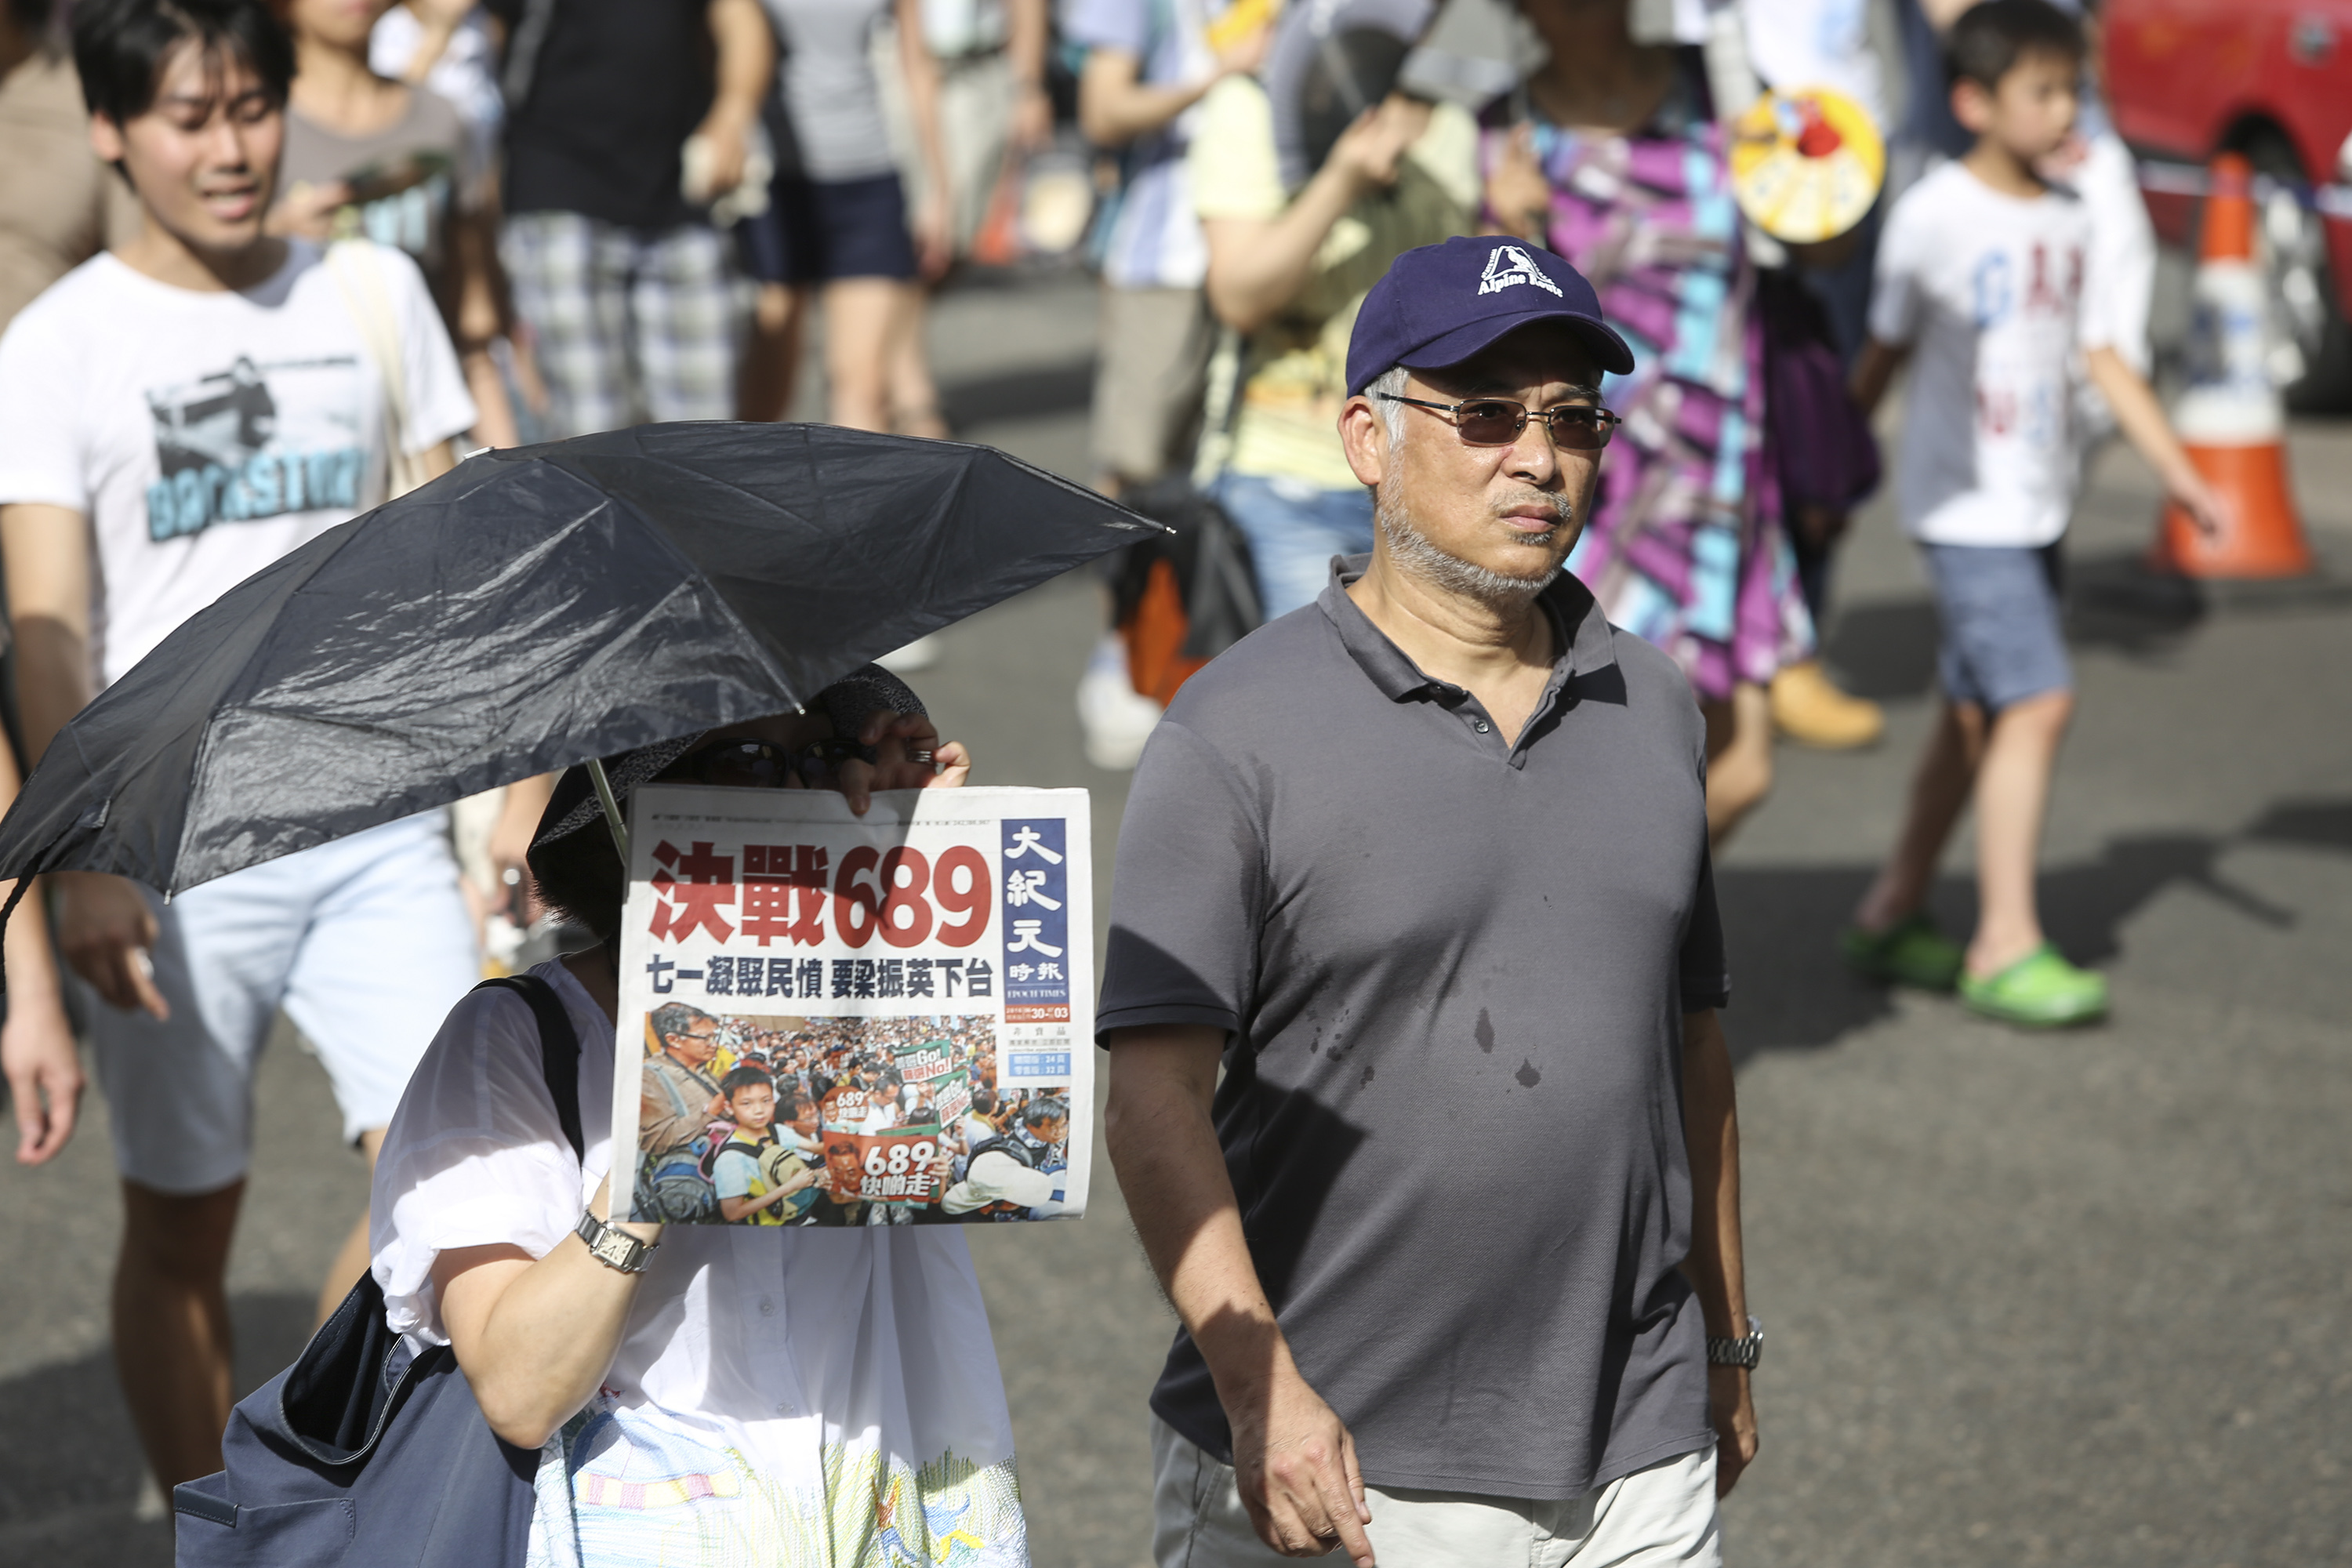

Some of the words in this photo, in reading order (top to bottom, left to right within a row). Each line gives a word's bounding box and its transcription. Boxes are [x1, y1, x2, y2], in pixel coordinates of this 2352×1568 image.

[1477, 273, 1526, 296] Alpine
[1528, 272, 1563, 298] Route
[648, 840, 992, 949] 決戰689
[1004, 826, 1064, 958] 大紀元
[646, 953, 823, 998] 七一凝聚民憤
[831, 957, 993, 998] 要梁振英下台
[1009, 962, 1065, 982] 時報
[1054, 1007, 1068, 1018] 03
[836, 1091, 865, 1108] 689
[864, 1141, 935, 1176] 689
